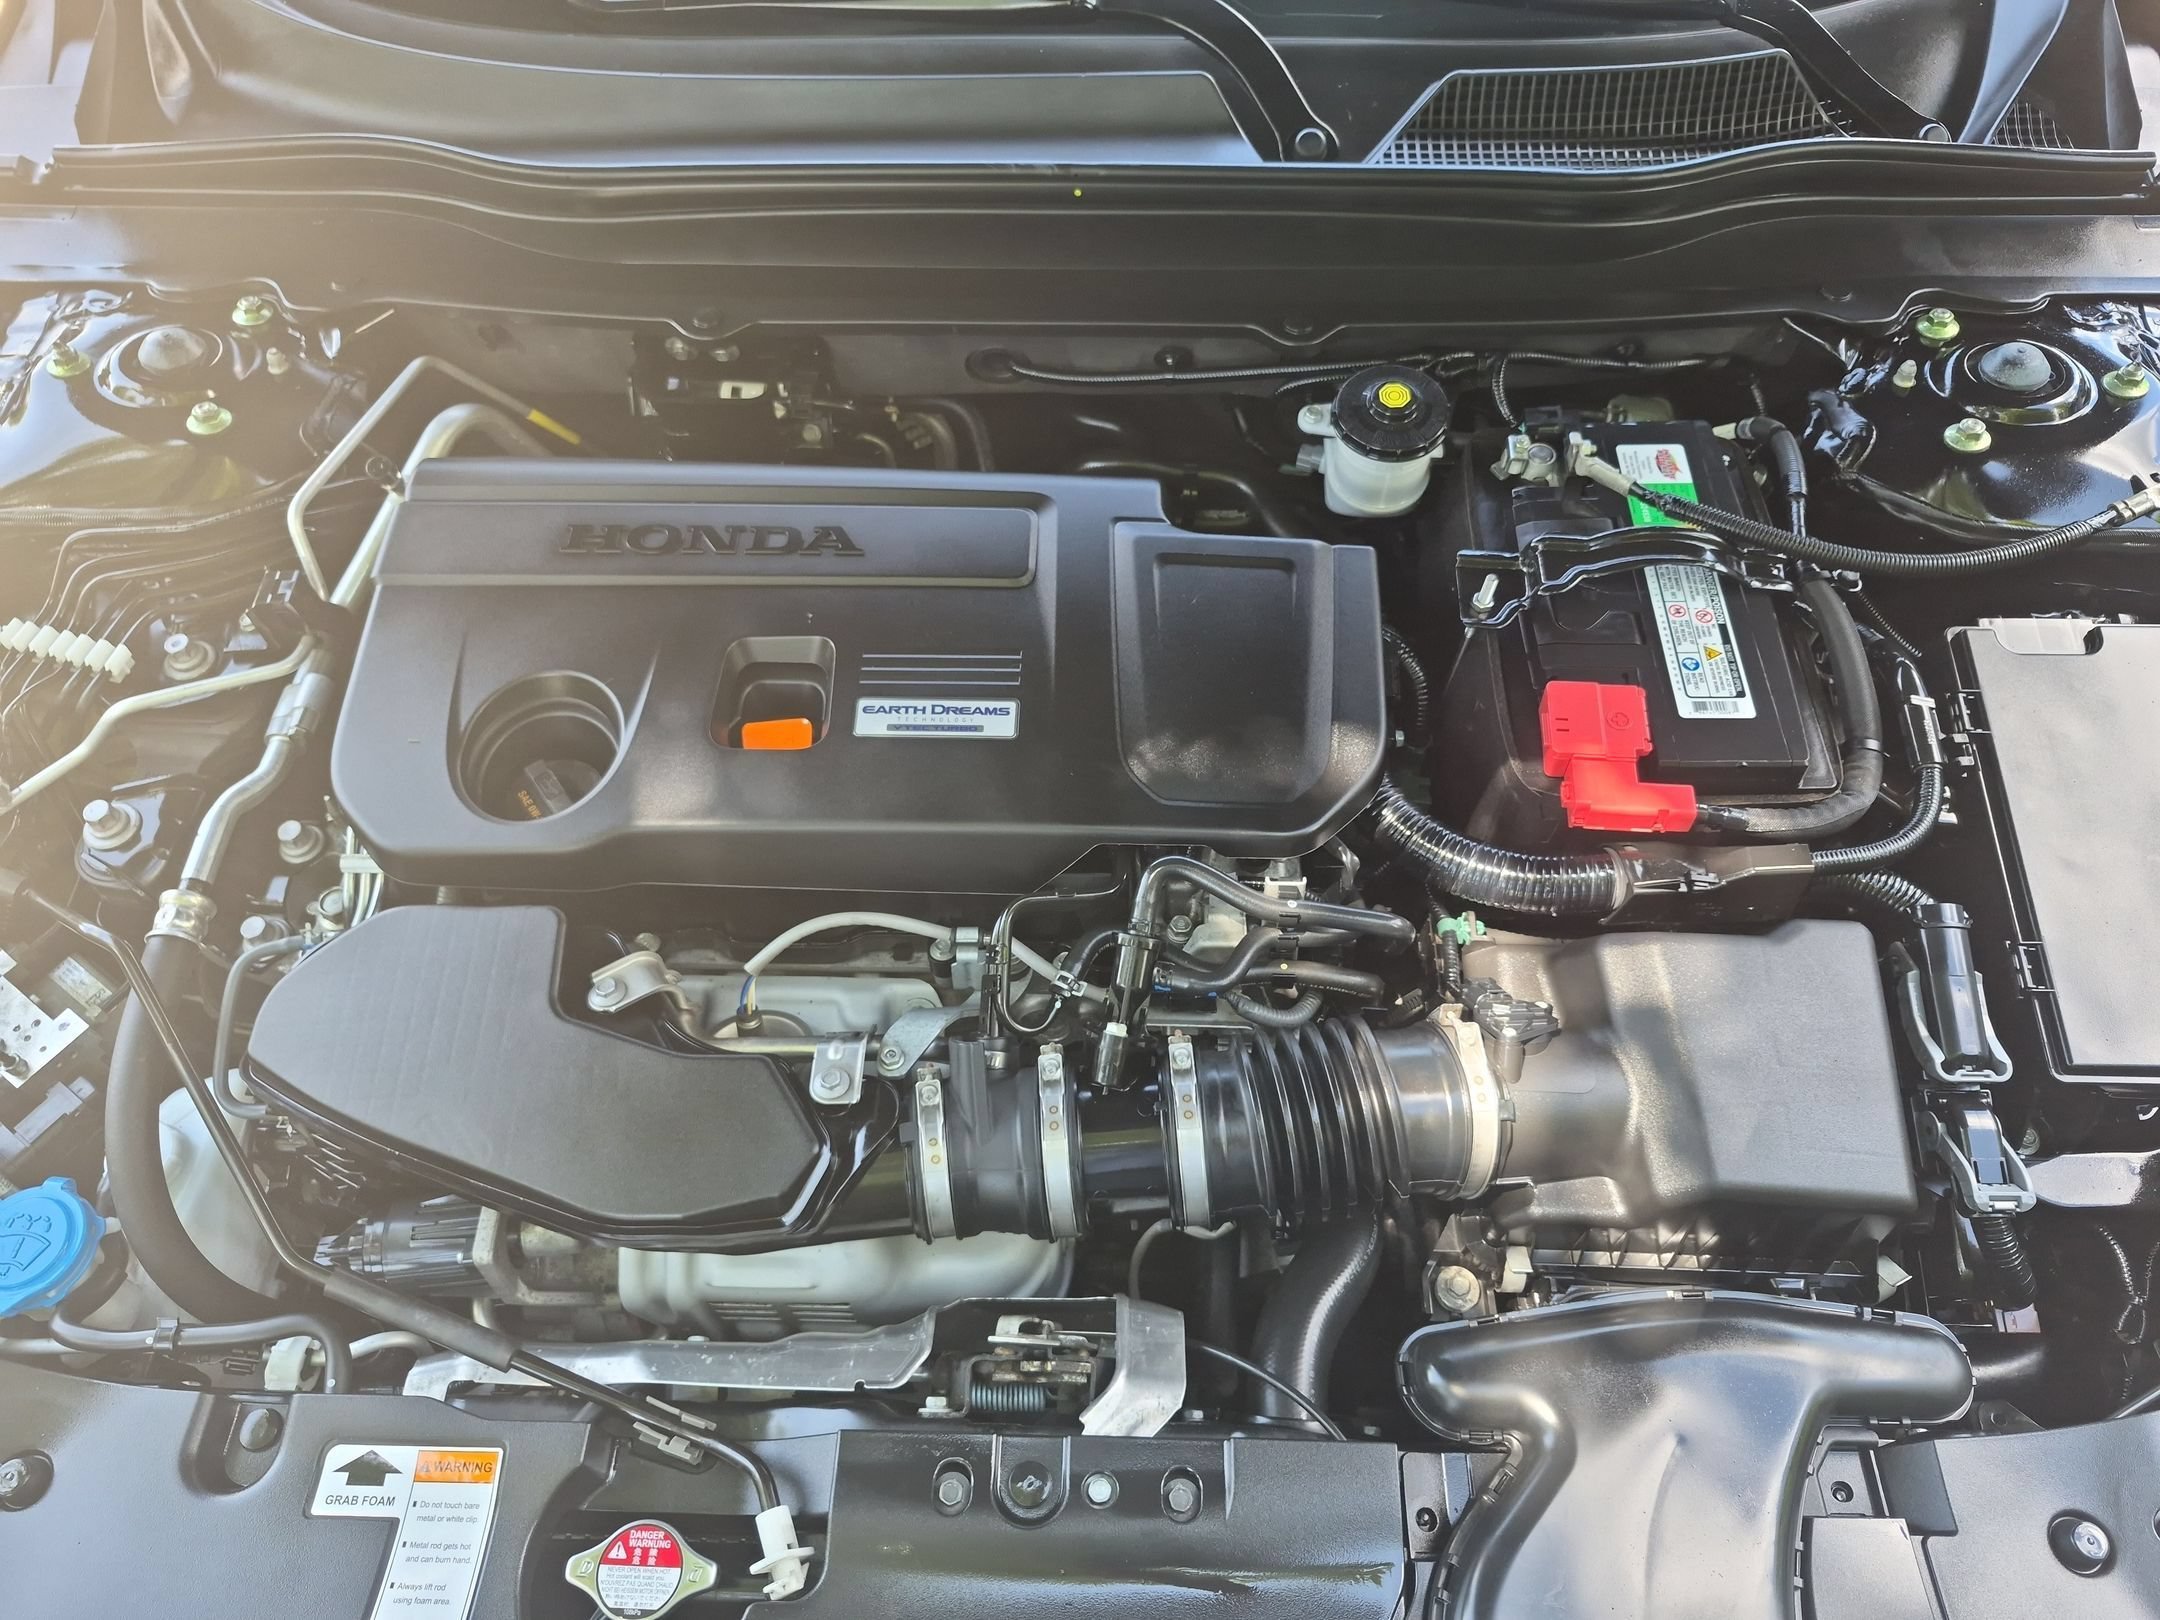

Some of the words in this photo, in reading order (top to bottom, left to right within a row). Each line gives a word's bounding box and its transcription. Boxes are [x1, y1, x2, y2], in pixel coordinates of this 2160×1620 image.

[559, 524, 866, 558] HONDA
[862, 705, 926, 715] EARTH
[931, 704, 1010, 716] DREAMS
[518, 790, 533, 807] SAE
[433, 1462, 493, 1473] WARNING
[325, 1495, 358, 1506] GRAB
[361, 1495, 396, 1507] FOAM
[420, 1500, 430, 1508] Do
[444, 1501, 463, 1509] touch
[464, 1501, 480, 1510] bare
[416, 1514, 436, 1522] metal
[446, 1515, 464, 1523] white
[630, 1530, 664, 1539] DANGER
[409, 1541, 429, 1549] Metal
[443, 1542, 458, 1551] gets
[629, 1538, 671, 1548] WARNUNG
[435, 1556, 451, 1564] burn
[397, 1582, 423, 1591] Always
[424, 1583, 433, 1591] lift
[393, 1597, 412, 1606] using
[414, 1597, 432, 1605] foam
